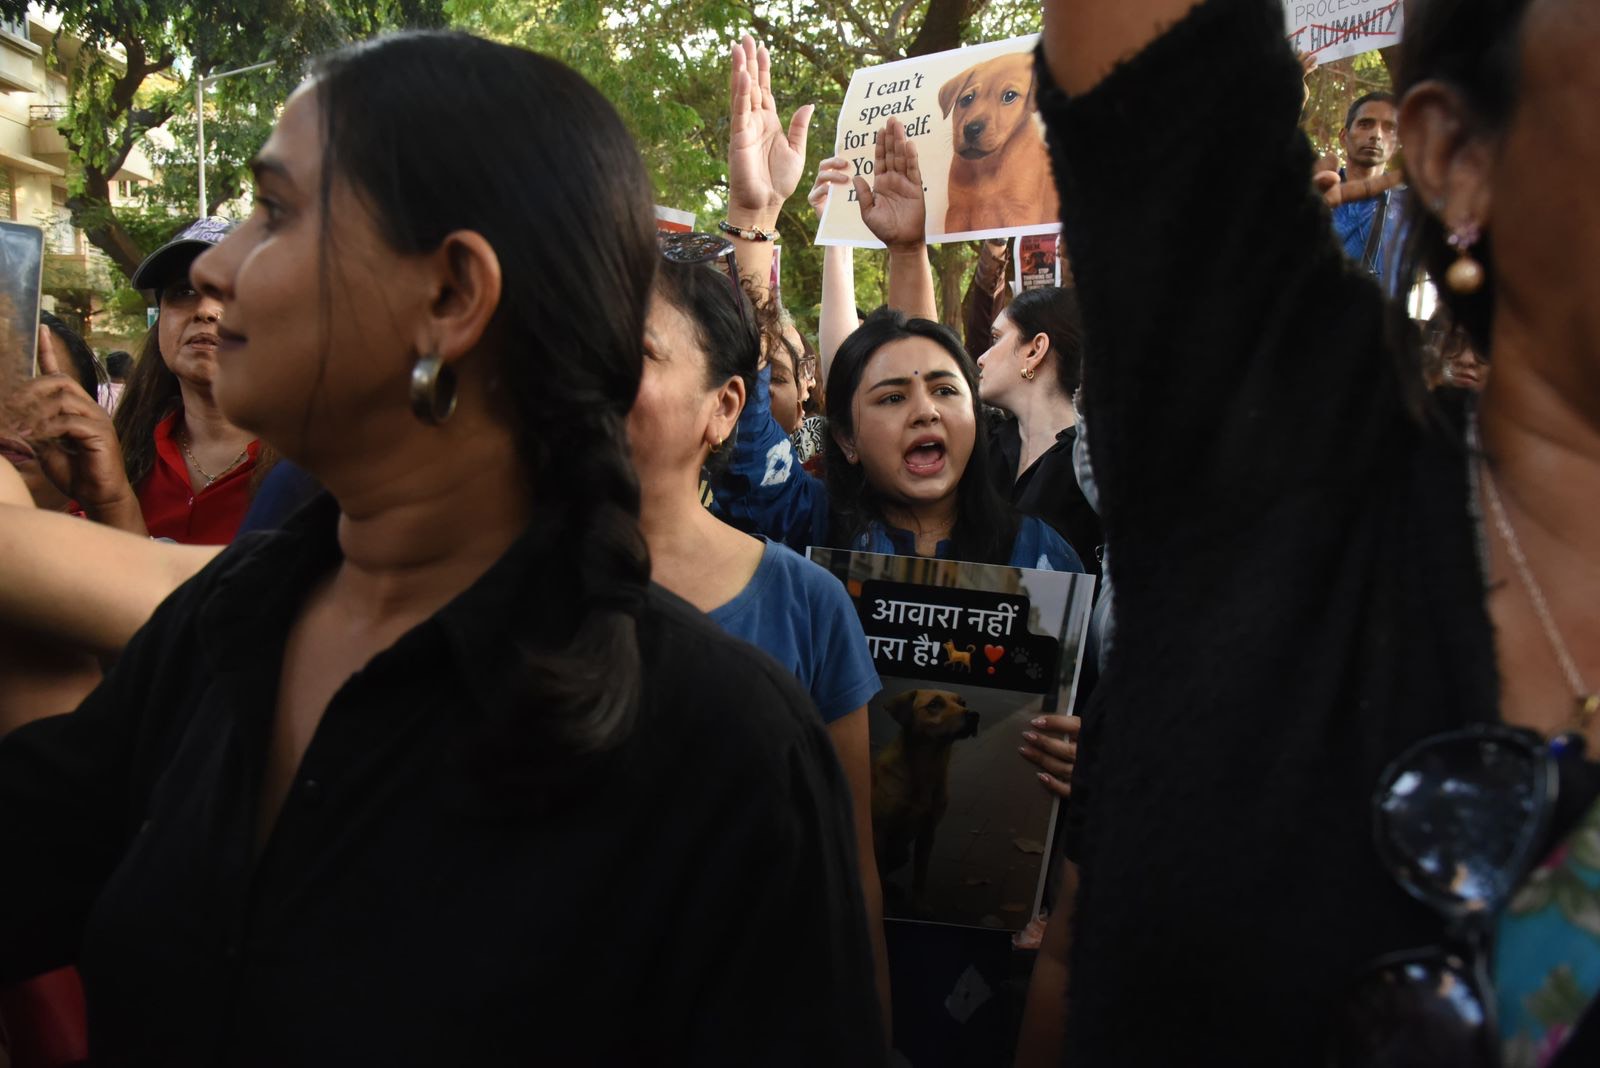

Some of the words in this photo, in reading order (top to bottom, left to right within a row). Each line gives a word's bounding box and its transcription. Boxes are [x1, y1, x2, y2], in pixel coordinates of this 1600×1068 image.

[1295, 0, 1369, 26] PROCES
[1311, 3, 1400, 51] HUMANITY
[865, 82, 873, 98] I
[877, 72, 924, 96] can't
[859, 95, 915, 125] speak
[844, 130, 869, 150] for
[852, 157, 873, 176] Yo
[872, 599, 963, 630] आवारा
[968, 603, 1020, 637] नहीं
[912, 633, 941, 667] है!
